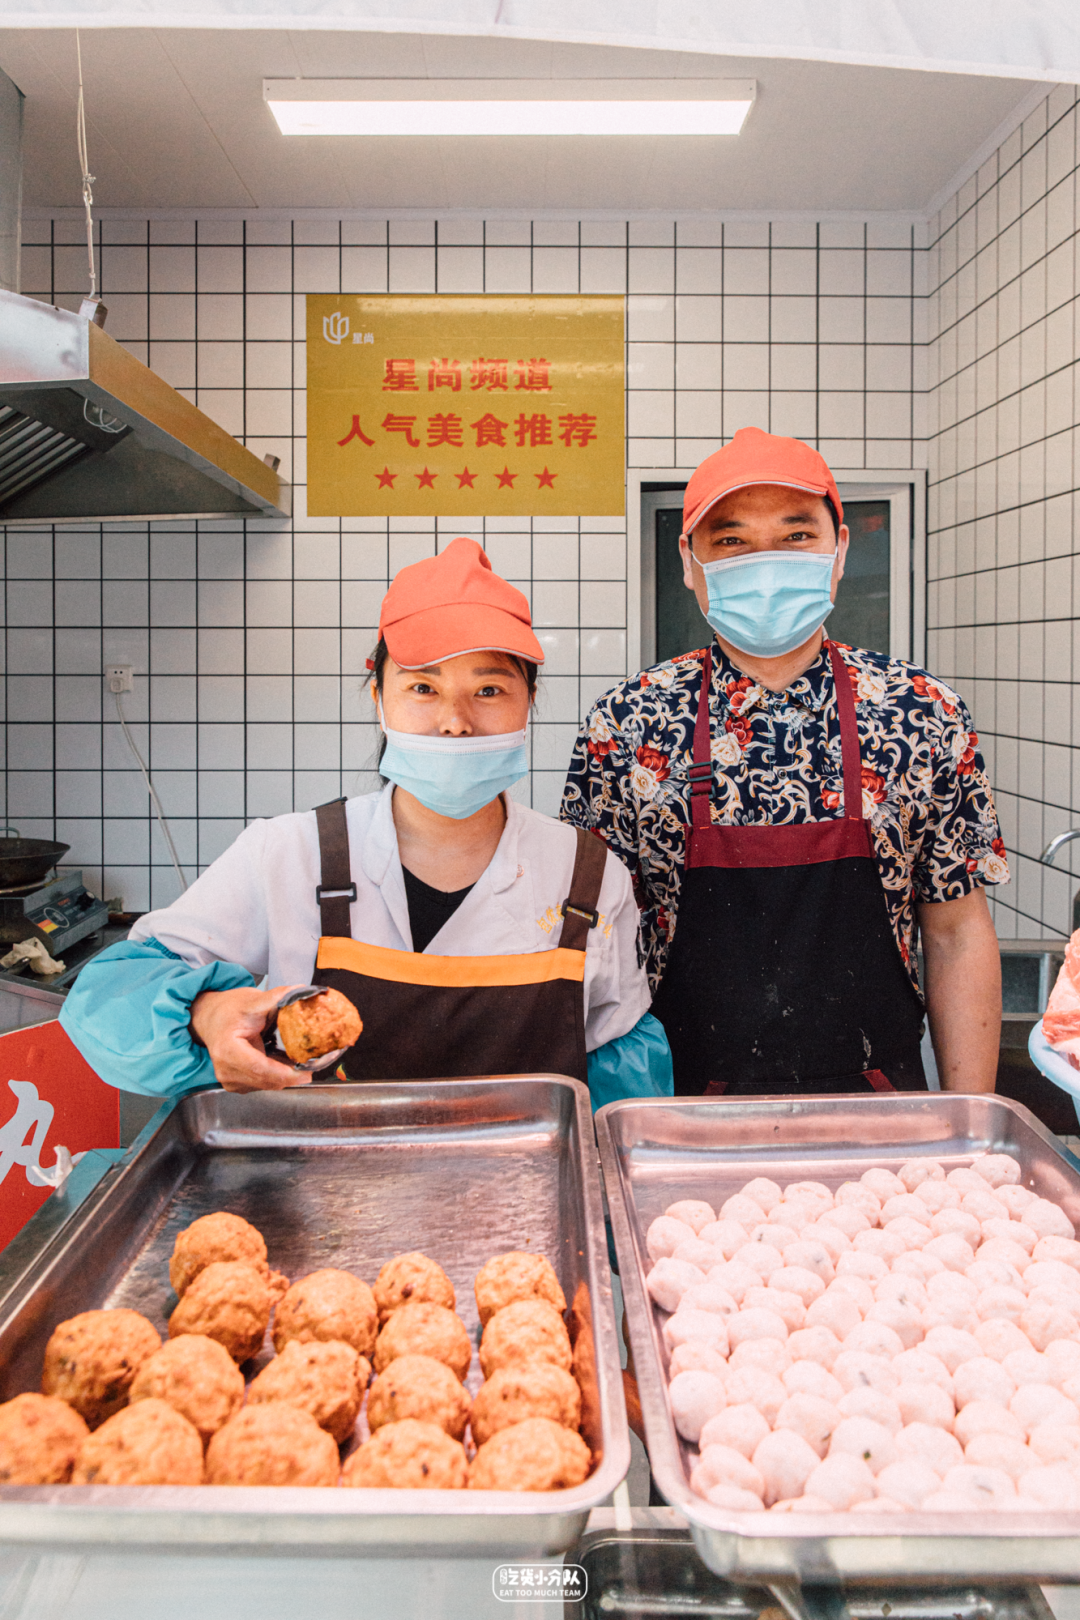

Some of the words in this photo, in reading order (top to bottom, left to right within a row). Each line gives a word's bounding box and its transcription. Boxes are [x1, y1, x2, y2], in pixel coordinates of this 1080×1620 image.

[352, 332, 374, 345] 星尚
[382, 357, 553, 392] 星尚频道
[337, 413, 597, 448] 人气美食推荐
